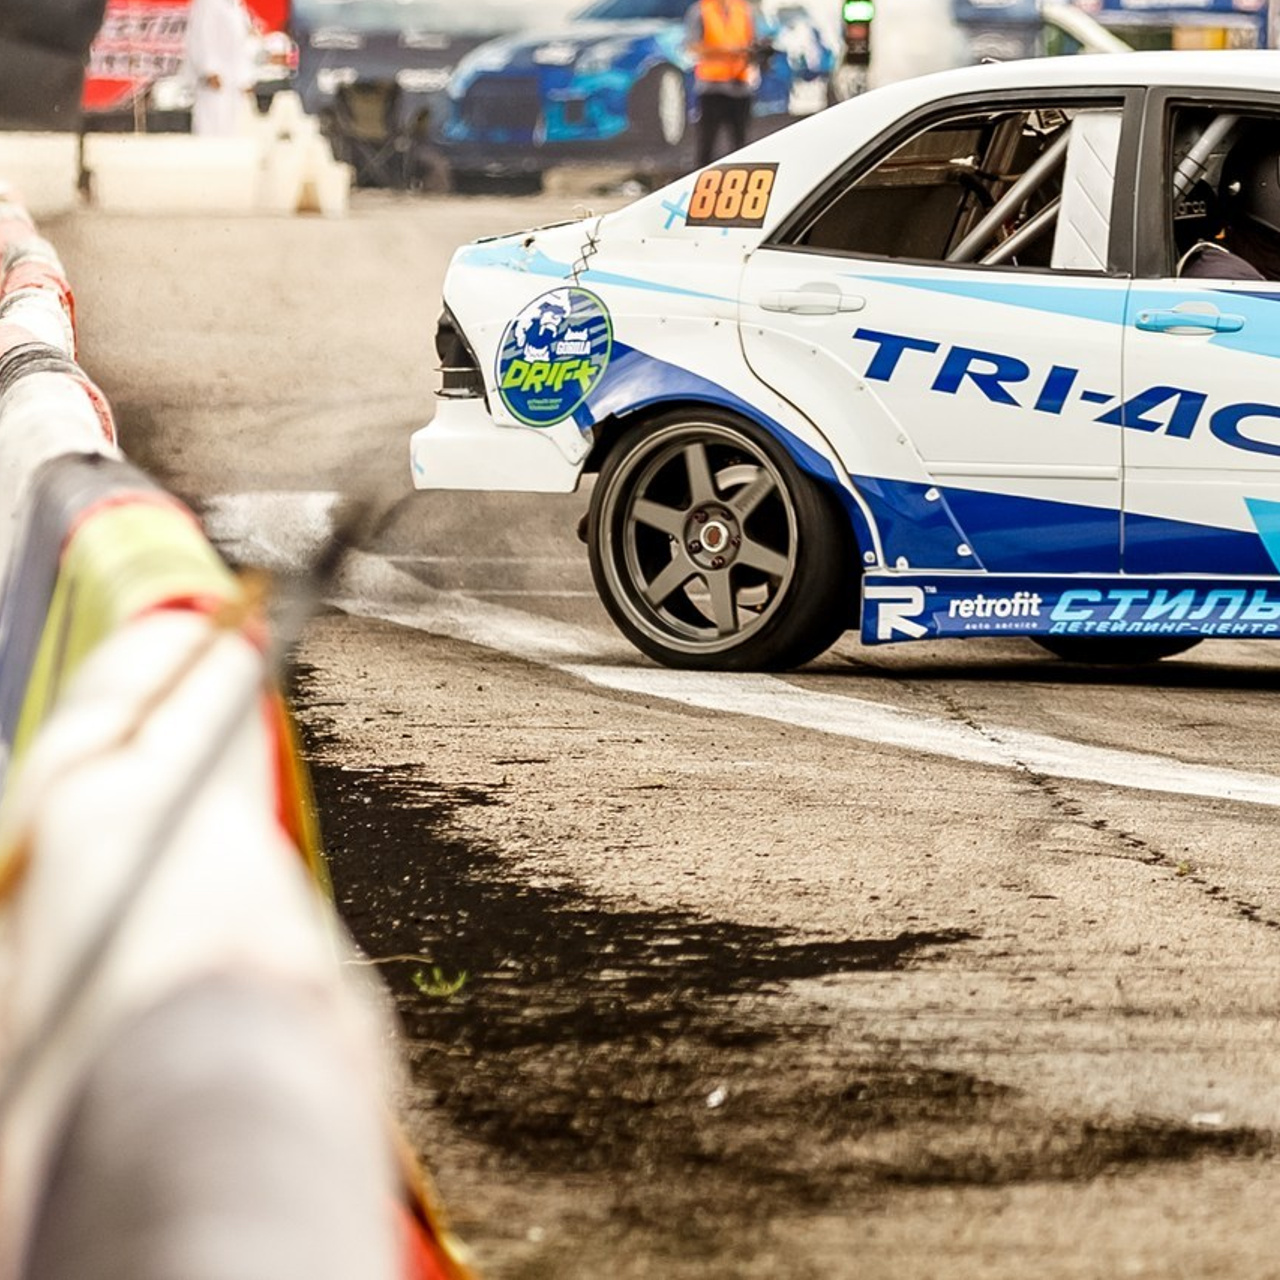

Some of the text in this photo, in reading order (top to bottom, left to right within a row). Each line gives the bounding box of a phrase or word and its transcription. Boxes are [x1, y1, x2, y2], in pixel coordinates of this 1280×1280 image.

[688, 169, 775, 220] 888
[501, 358, 598, 394] DRIFT
[949, 591, 1042, 618] retrofit
